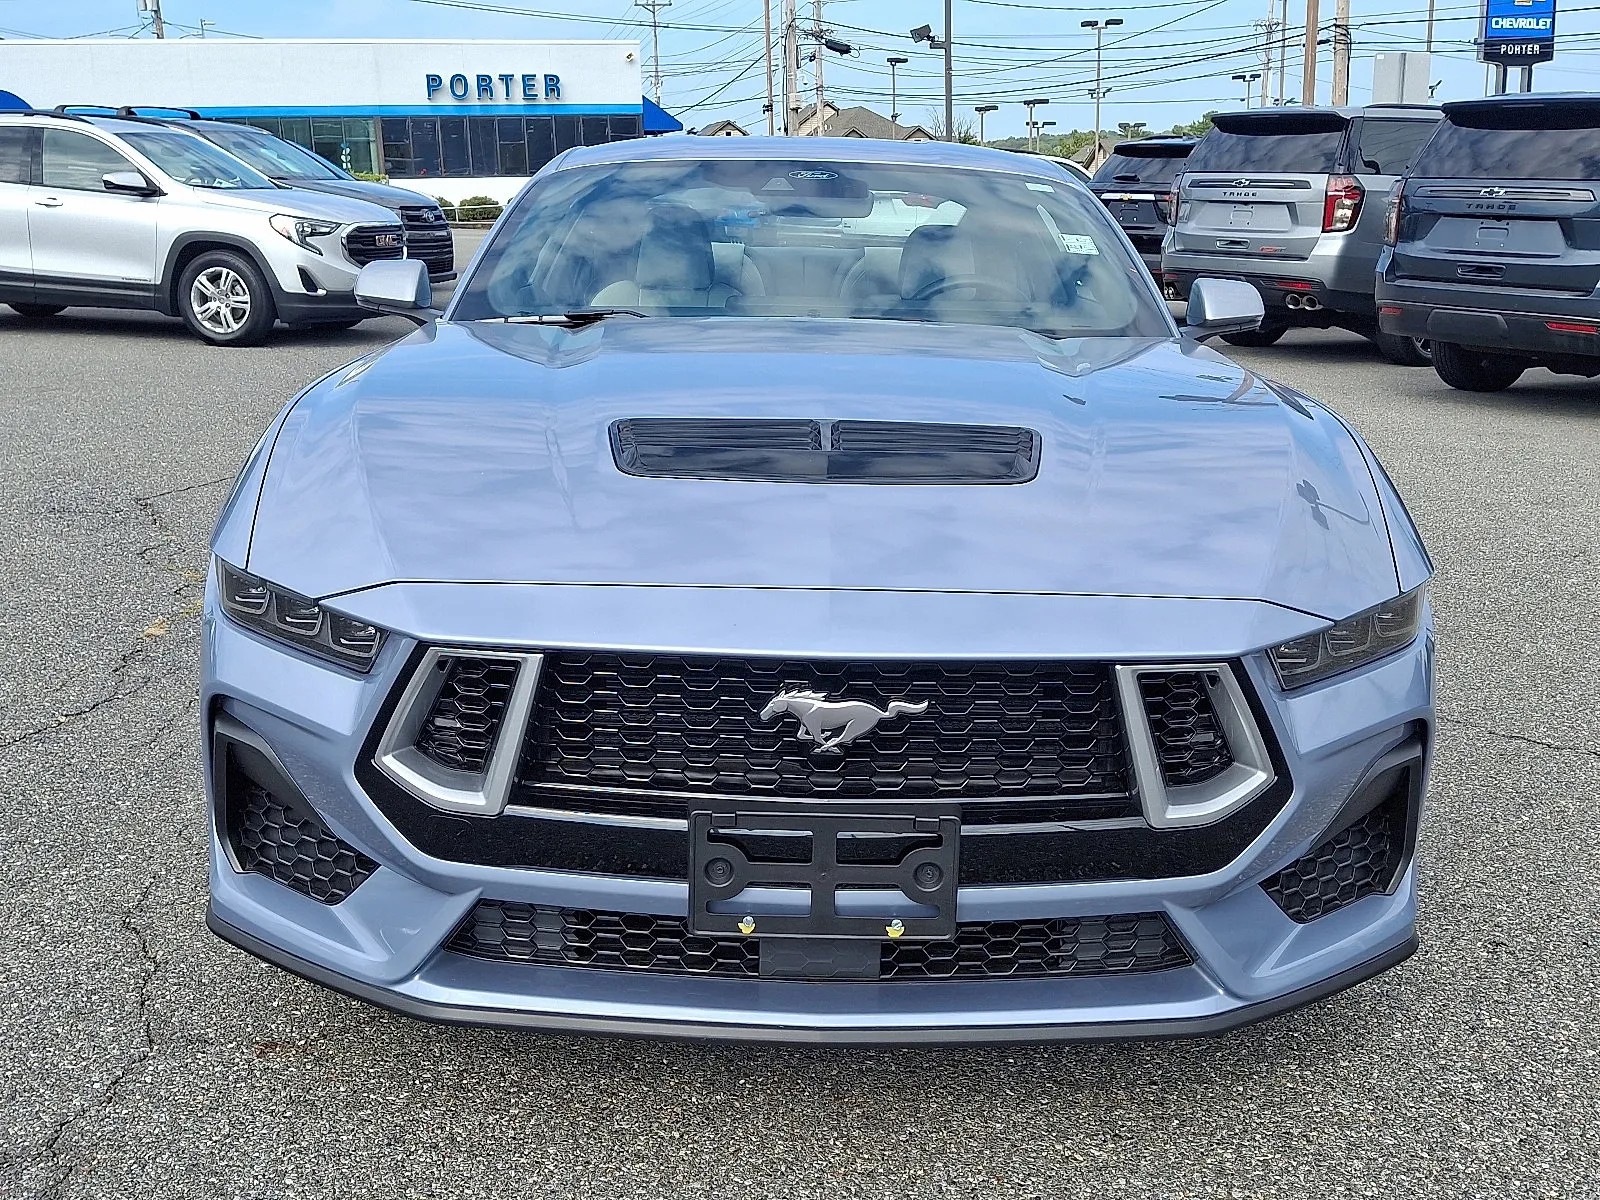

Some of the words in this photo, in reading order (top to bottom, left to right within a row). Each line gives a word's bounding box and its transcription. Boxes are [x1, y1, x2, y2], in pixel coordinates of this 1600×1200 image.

[1491, 17, 1552, 29] CHEVROLET
[1500, 44, 1540, 55] PORTER
[426, 74, 561, 100] PORTER
[1465, 203, 1517, 211] TAHOE
[375, 234, 398, 247] GMC
